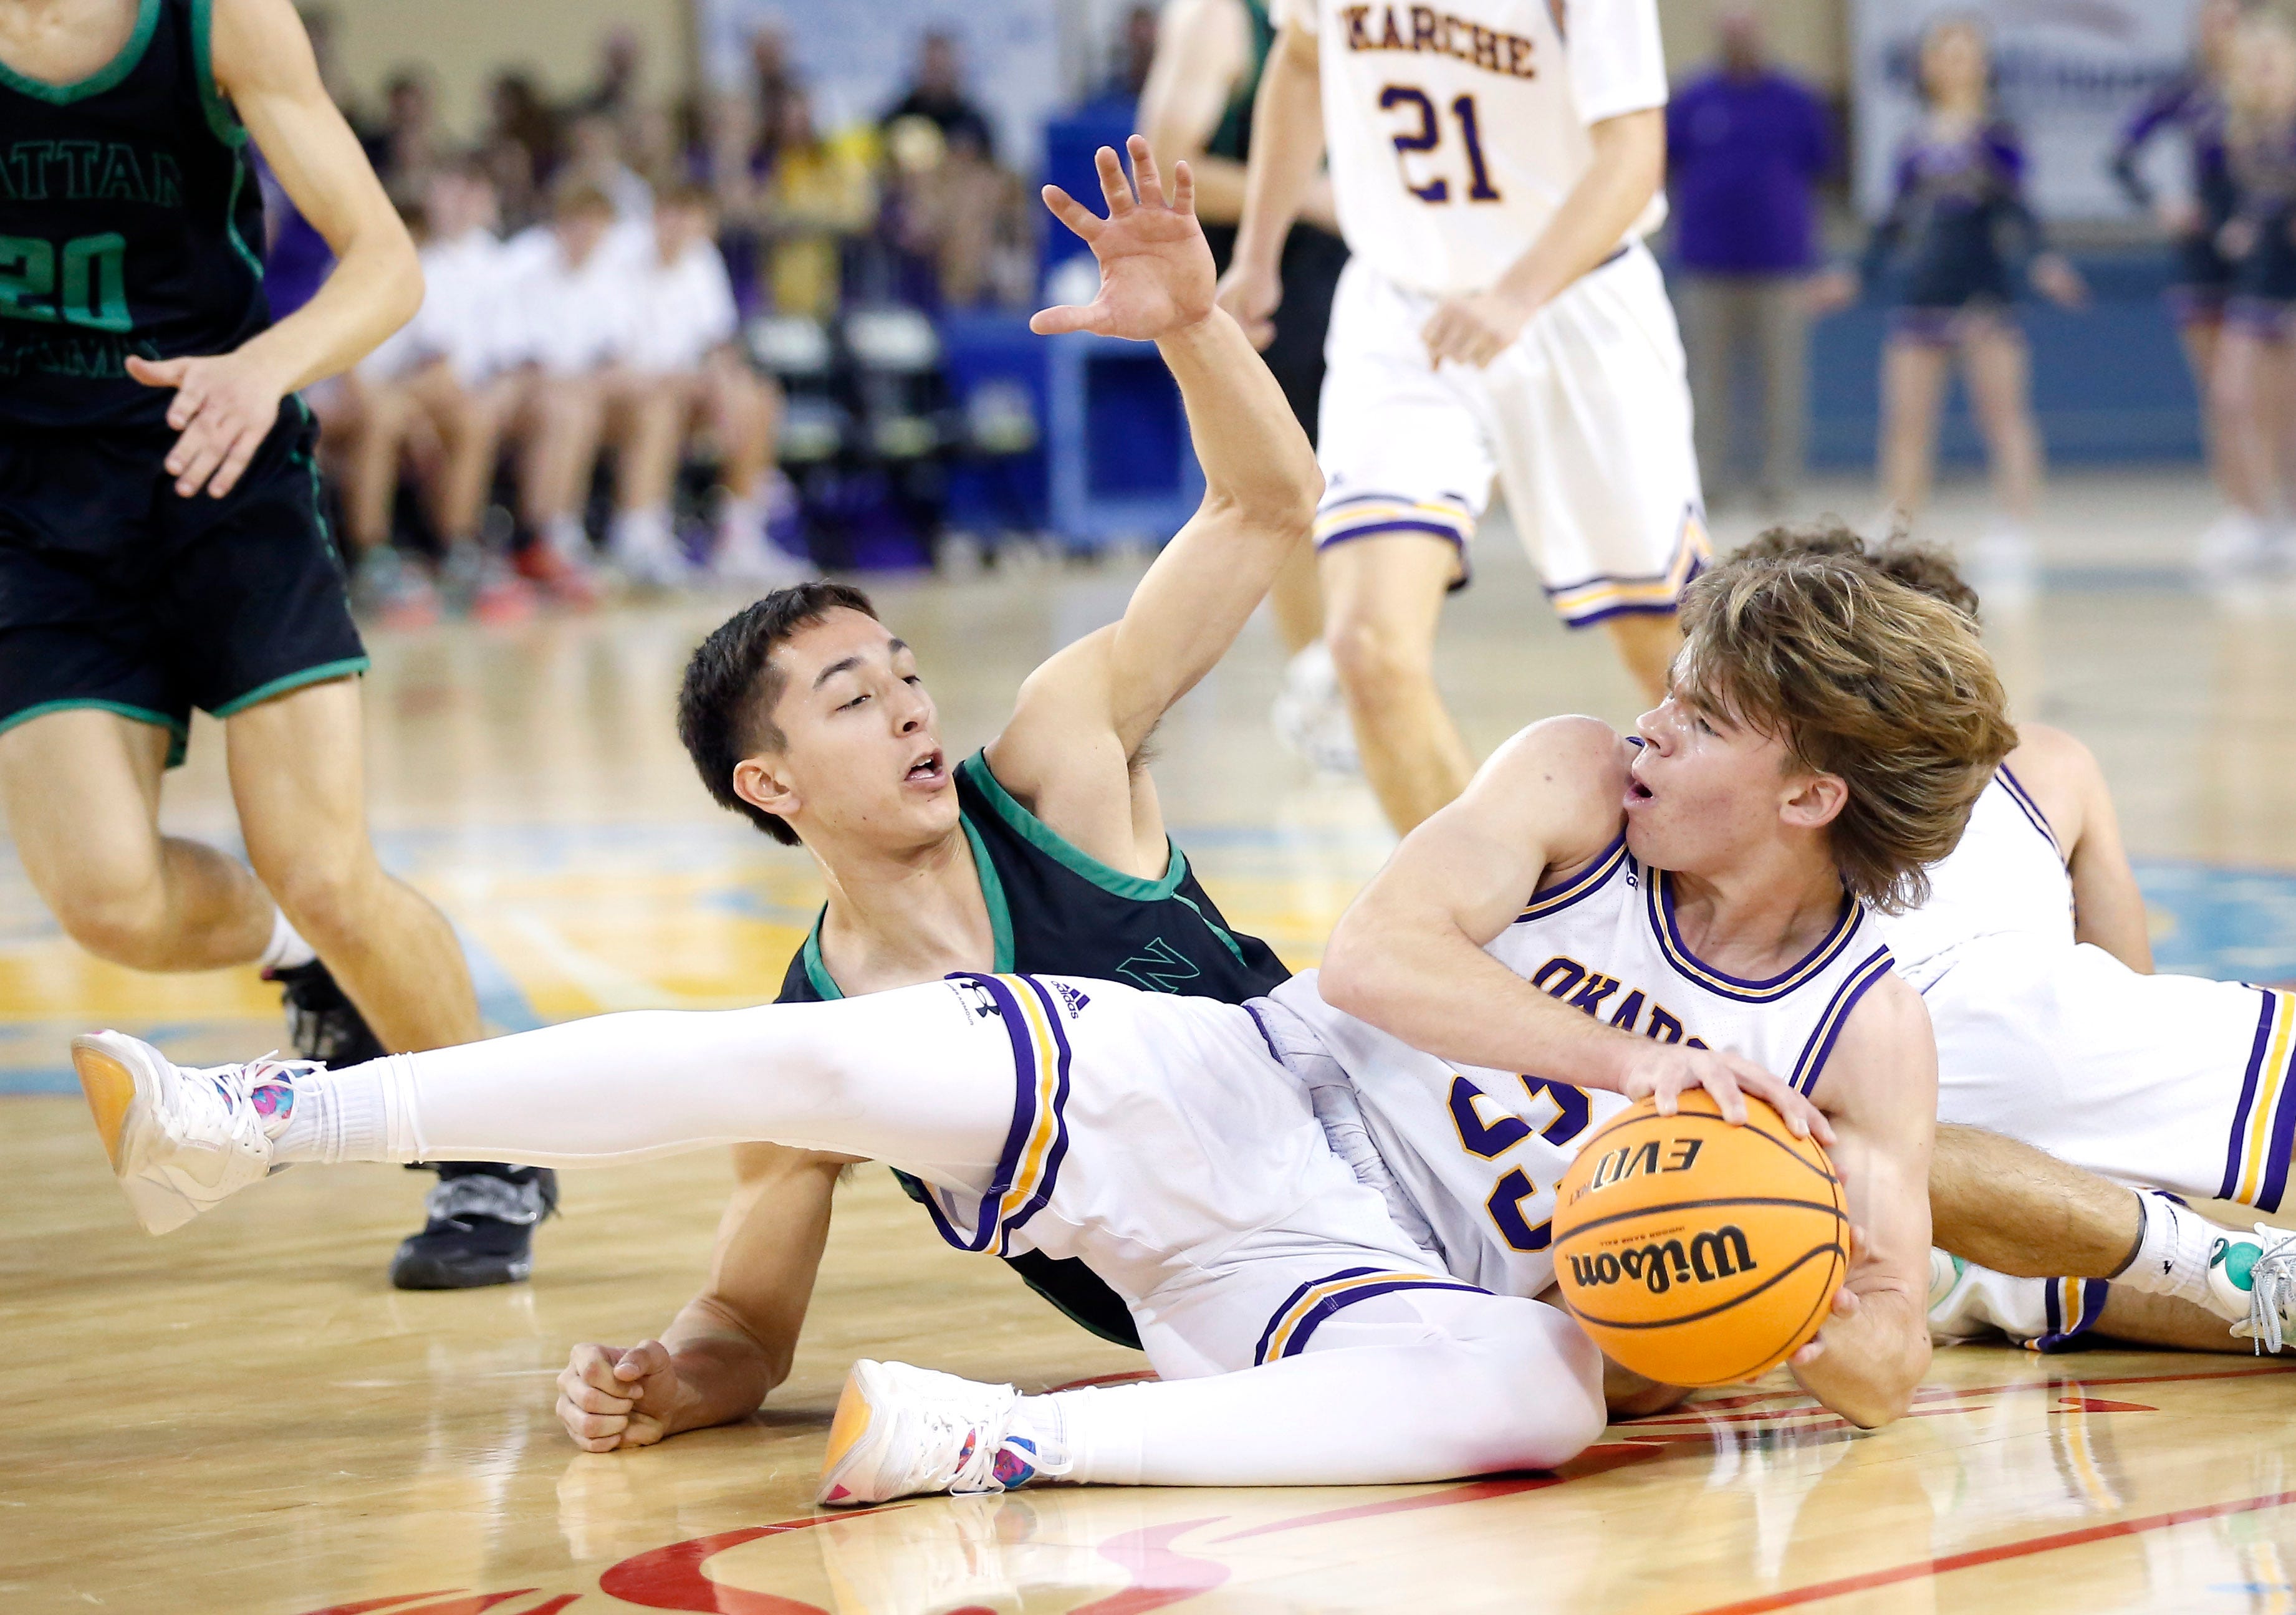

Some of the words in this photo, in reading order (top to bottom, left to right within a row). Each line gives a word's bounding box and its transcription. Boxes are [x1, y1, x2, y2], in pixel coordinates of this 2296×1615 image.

[1379, 85, 1501, 203] 21
[0, 231, 133, 333] 20
[1051, 980, 1078, 1019] adidas
[1530, 955, 1713, 1051] OKAR
[1592, 1138, 1703, 1192] EVO
[1569, 1224, 1758, 1295] Wilson
